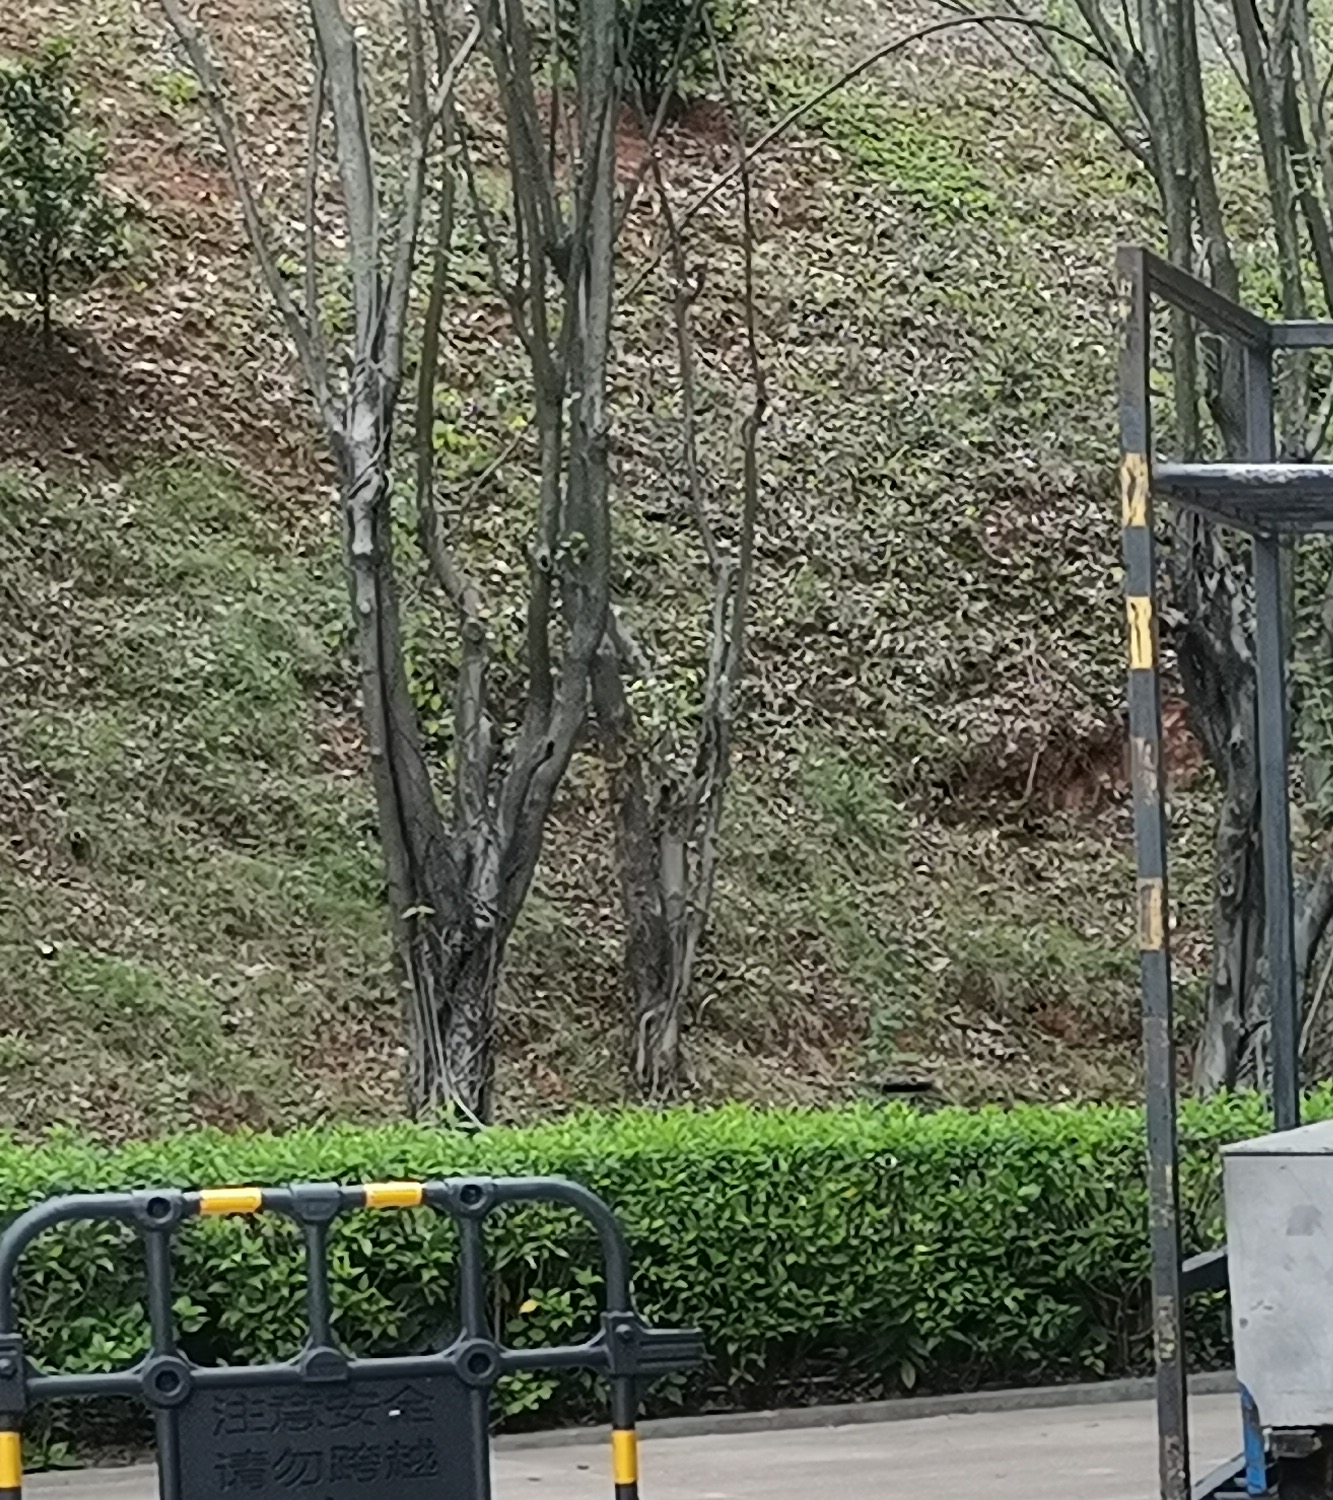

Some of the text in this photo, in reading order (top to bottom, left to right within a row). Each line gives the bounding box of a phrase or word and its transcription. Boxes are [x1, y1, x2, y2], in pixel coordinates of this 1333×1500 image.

[213, 1383, 436, 1437] 注意安全
[213, 1438, 439, 1491] 请勿跨越
